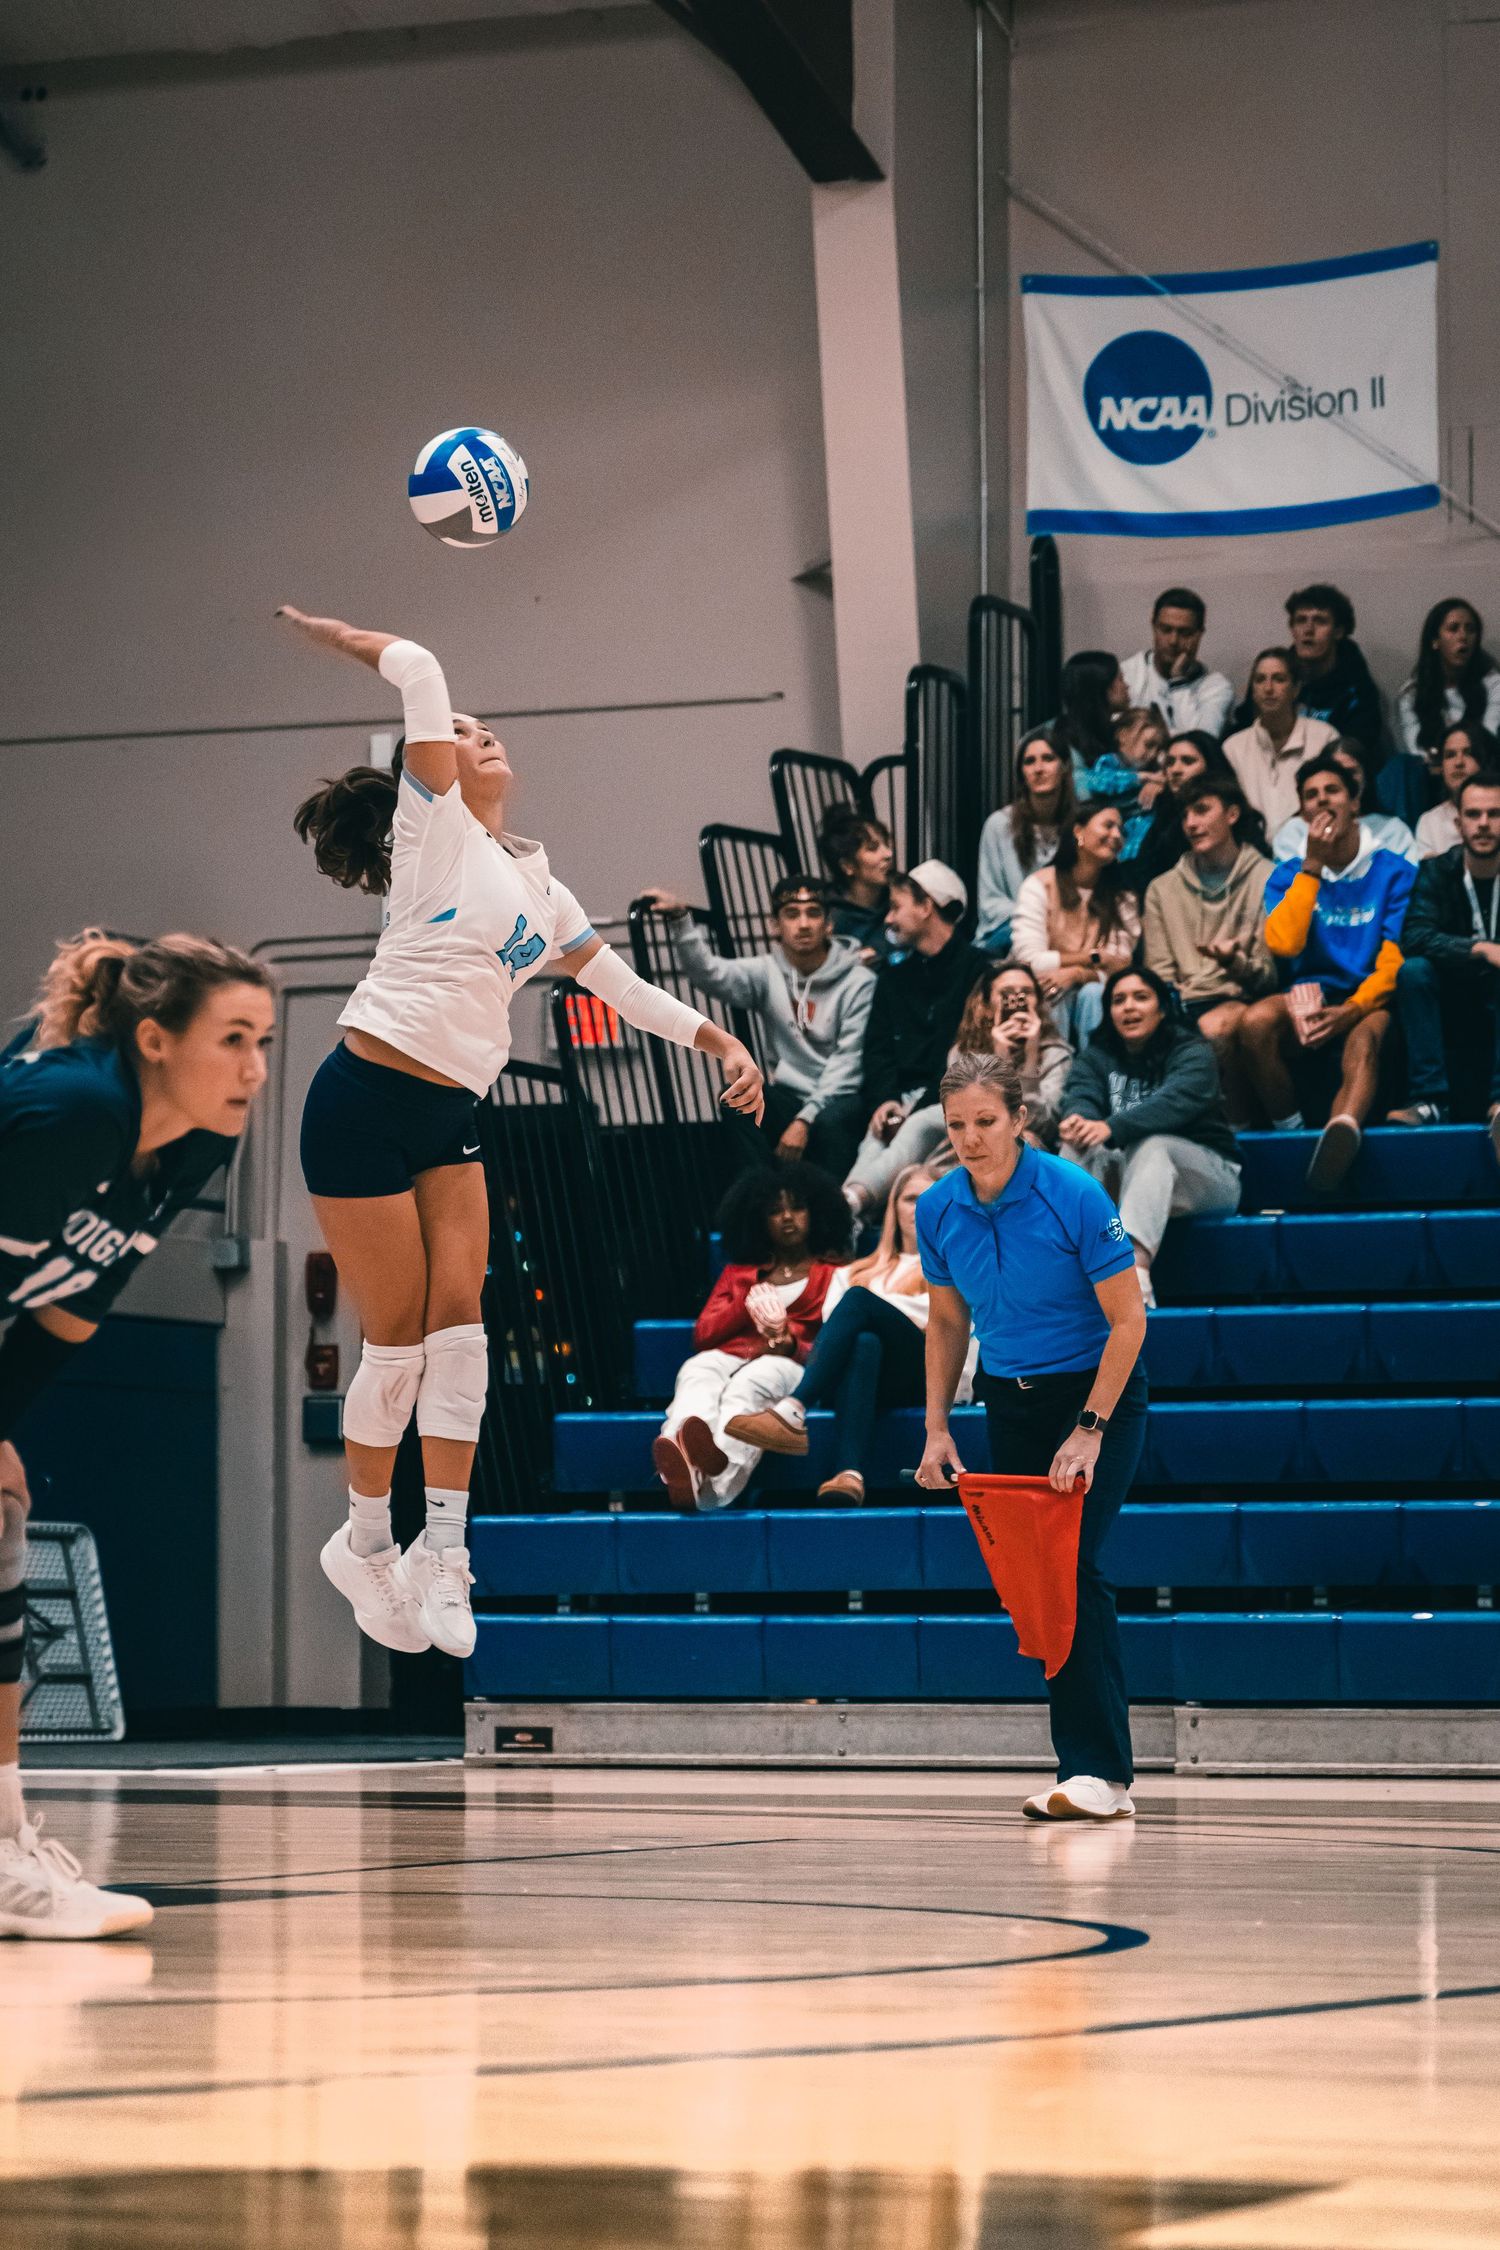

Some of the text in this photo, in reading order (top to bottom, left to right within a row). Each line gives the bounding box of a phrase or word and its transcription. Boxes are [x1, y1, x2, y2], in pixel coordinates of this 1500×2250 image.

[1098, 374, 1385, 431] NCAA Division II
[460, 460, 494, 523] molten
[478, 456, 513, 509] NCAA
